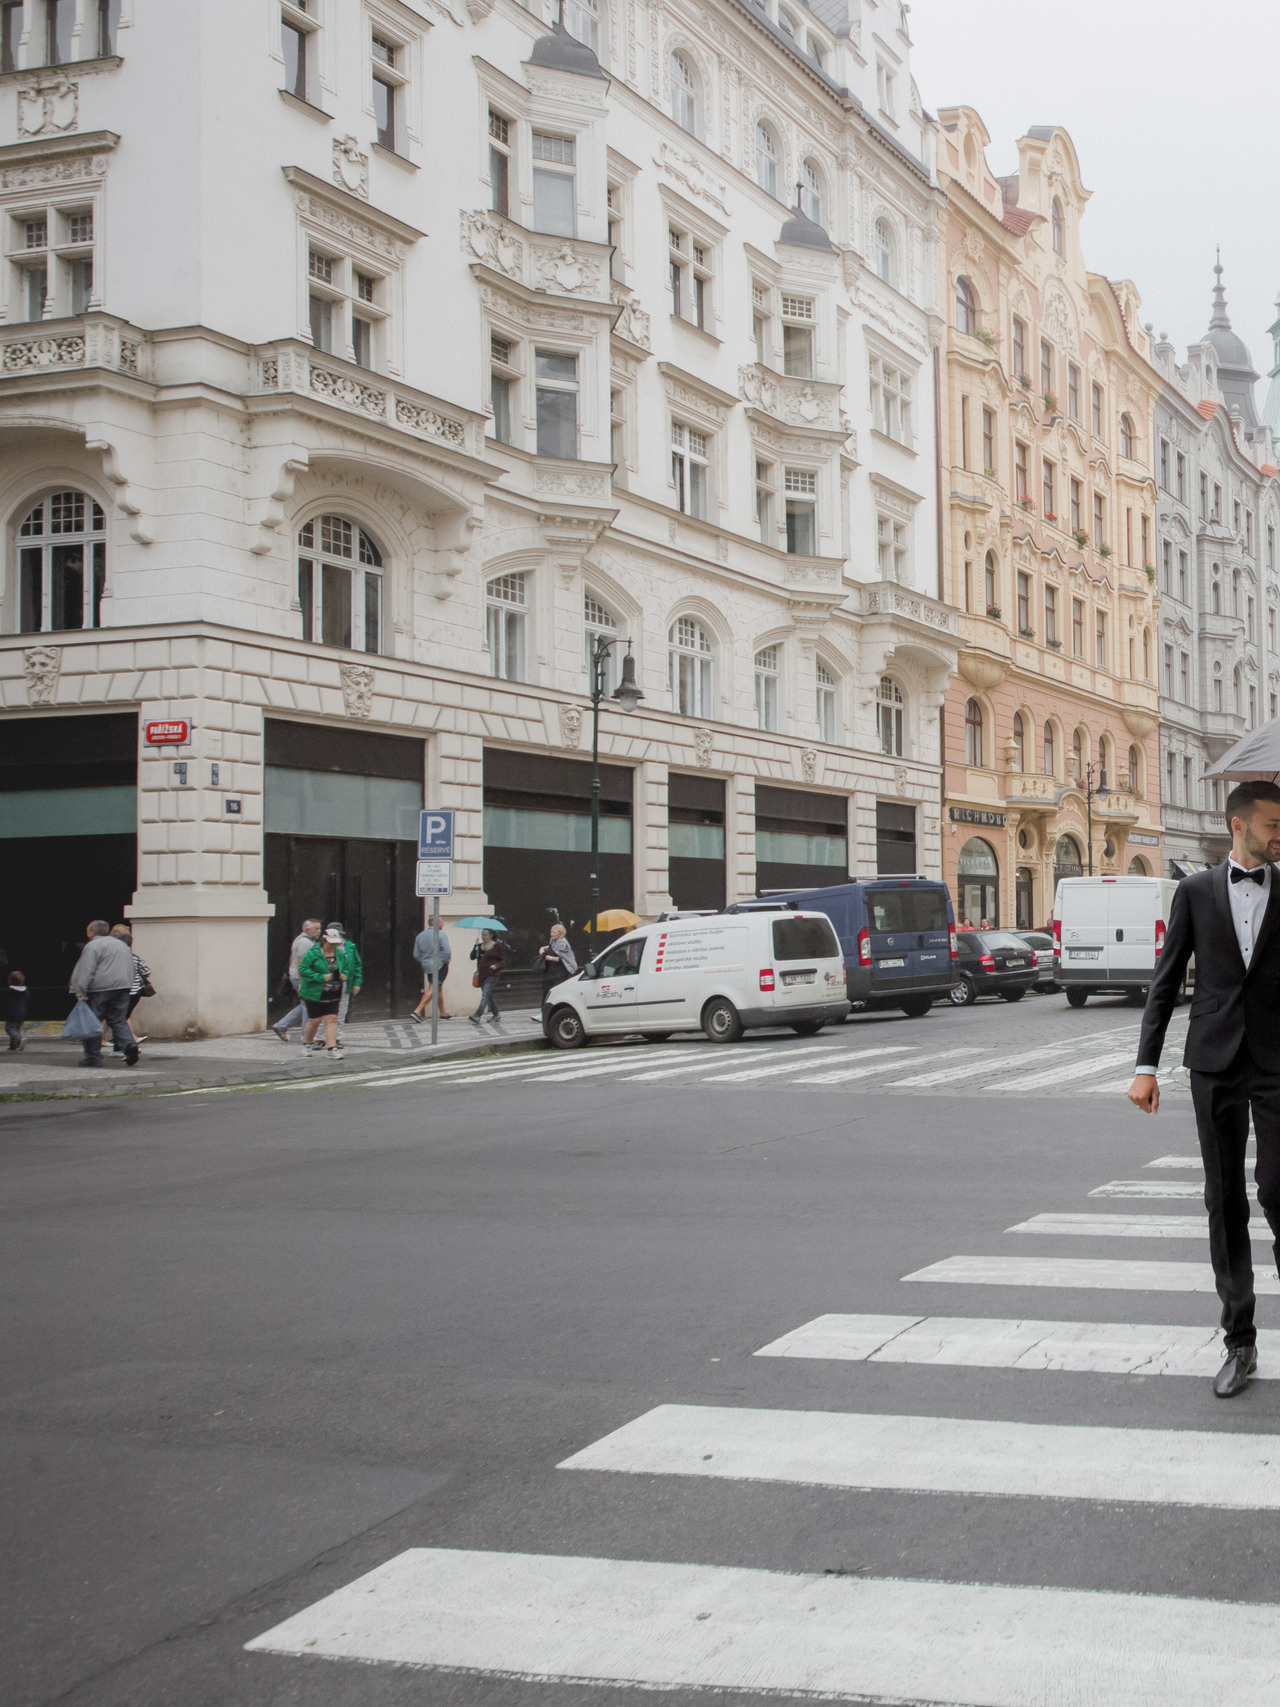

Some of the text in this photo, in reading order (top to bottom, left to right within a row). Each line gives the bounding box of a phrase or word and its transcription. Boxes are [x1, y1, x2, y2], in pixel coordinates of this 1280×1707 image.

[150, 724, 183, 735] PAŘÍŽSKÁ
[229, 802, 239, 811] 16
[426, 816, 447, 844] P
[421, 846, 451, 854] RÉSERVÉ
